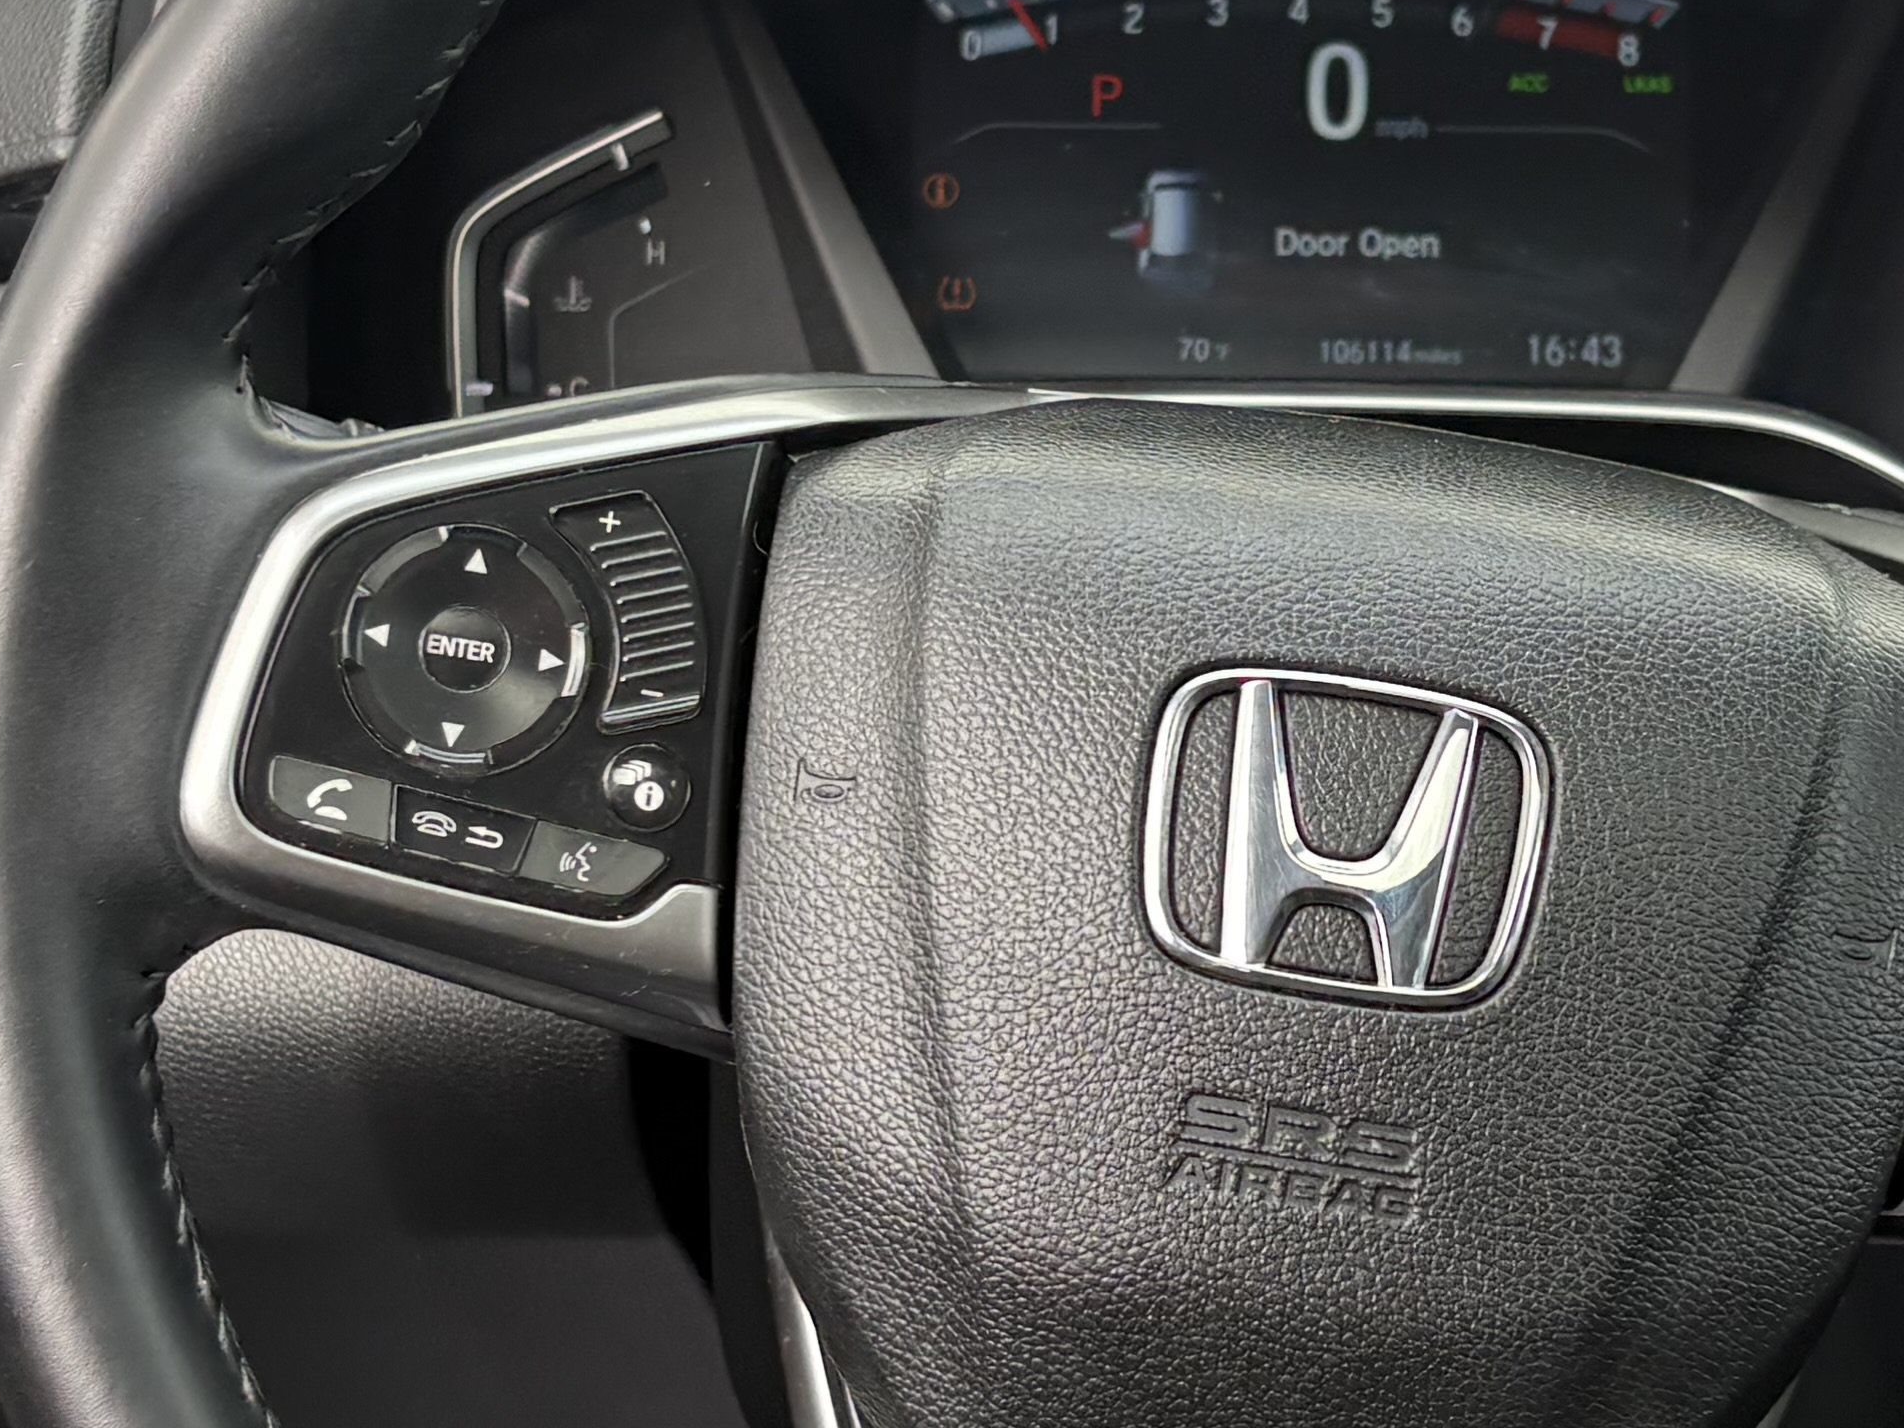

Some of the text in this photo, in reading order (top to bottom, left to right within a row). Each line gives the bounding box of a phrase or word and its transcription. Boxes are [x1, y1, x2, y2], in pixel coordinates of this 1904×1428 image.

[1047, 14, 1058, 46] 1
[1122, 2, 1144, 34] 2
[1451, 4, 1474, 37] 6
[1537, 17, 1560, 50] 7
[1617, 33, 1640, 66] 8
[1092, 74, 1124, 117] P
[1306, 41, 1369, 141] 0
[644, 240, 667, 266] H
[1274, 226, 1441, 263] Door Open
[1527, 333, 1623, 368] 16:43
[426, 633, 496, 664] ENTER
[1184, 1091, 1418, 1174] SRS
[1162, 1153, 1418, 1220] AIRBAG
